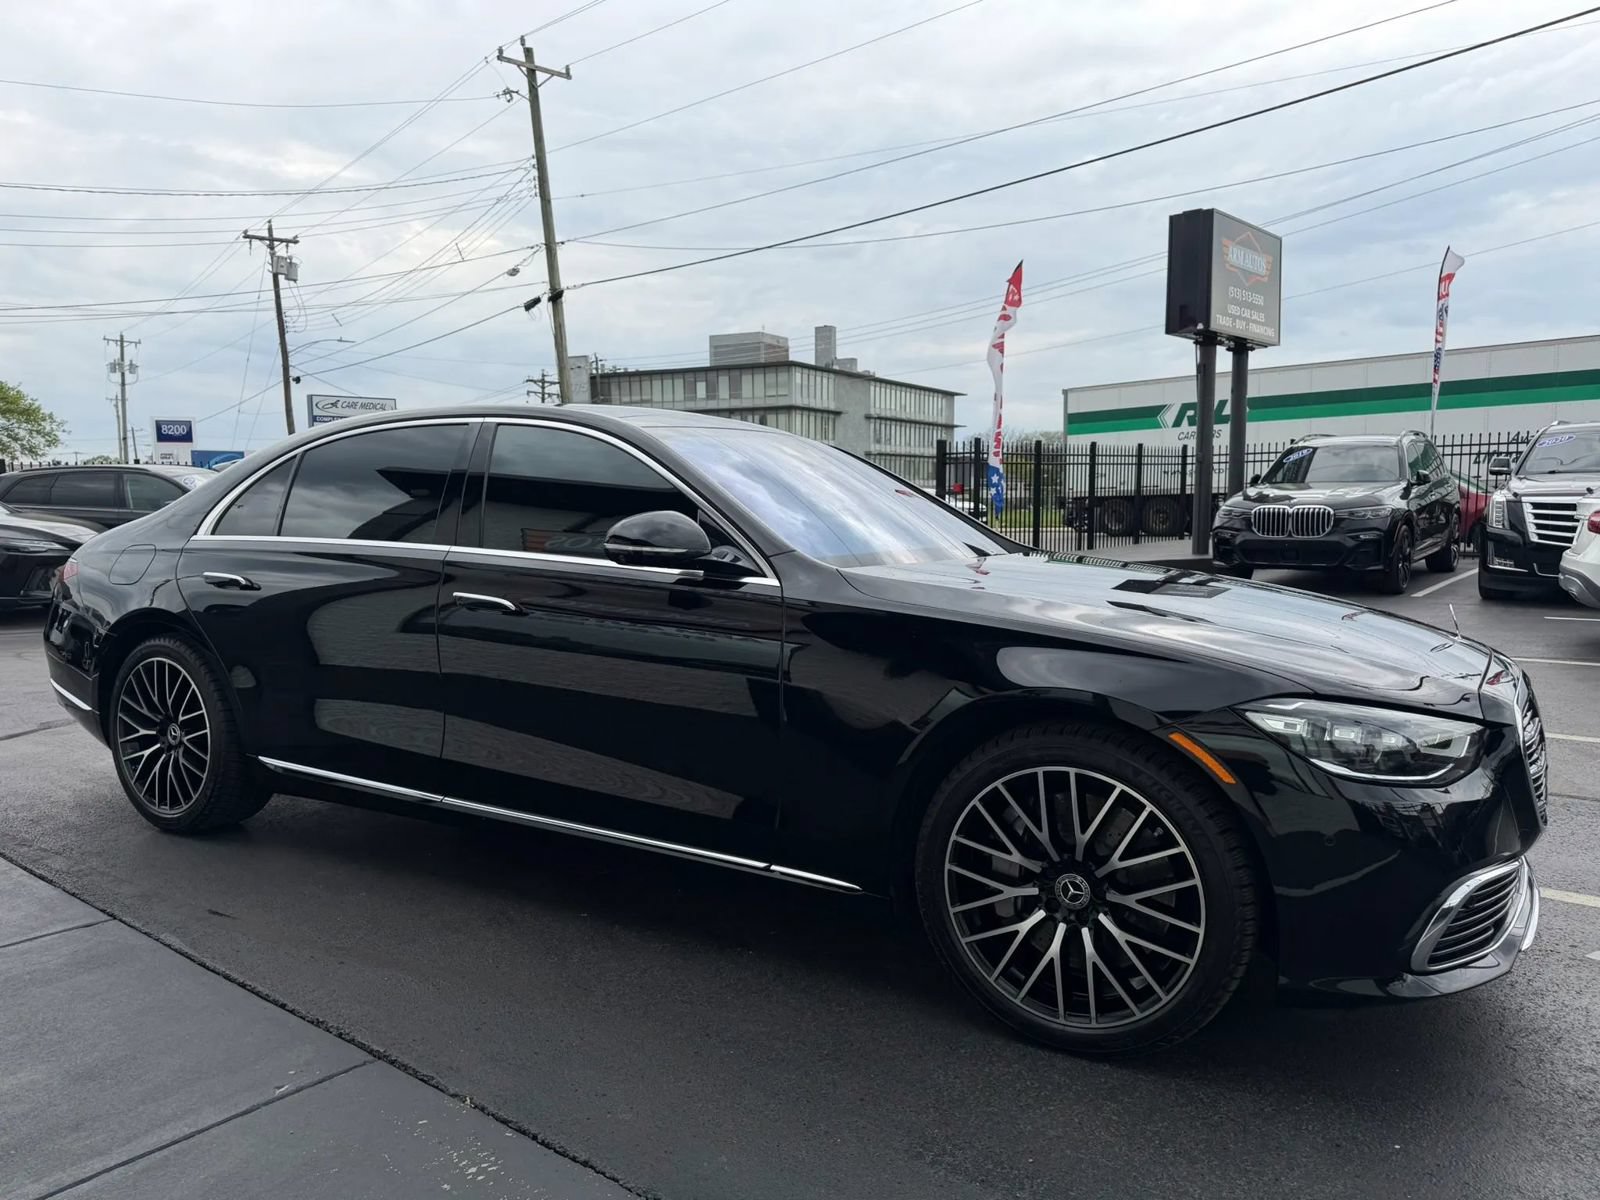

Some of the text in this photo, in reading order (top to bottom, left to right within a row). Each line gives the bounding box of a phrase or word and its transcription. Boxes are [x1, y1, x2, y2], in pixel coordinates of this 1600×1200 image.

[1227, 304, 1265, 322] USED CAR SALES
[1216, 314, 1275, 337] TRADE BUY FINANCING
[341, 401, 359, 411] CARE
[358, 403, 388, 413] MEDICAL
[161, 424, 187, 435] 8200
